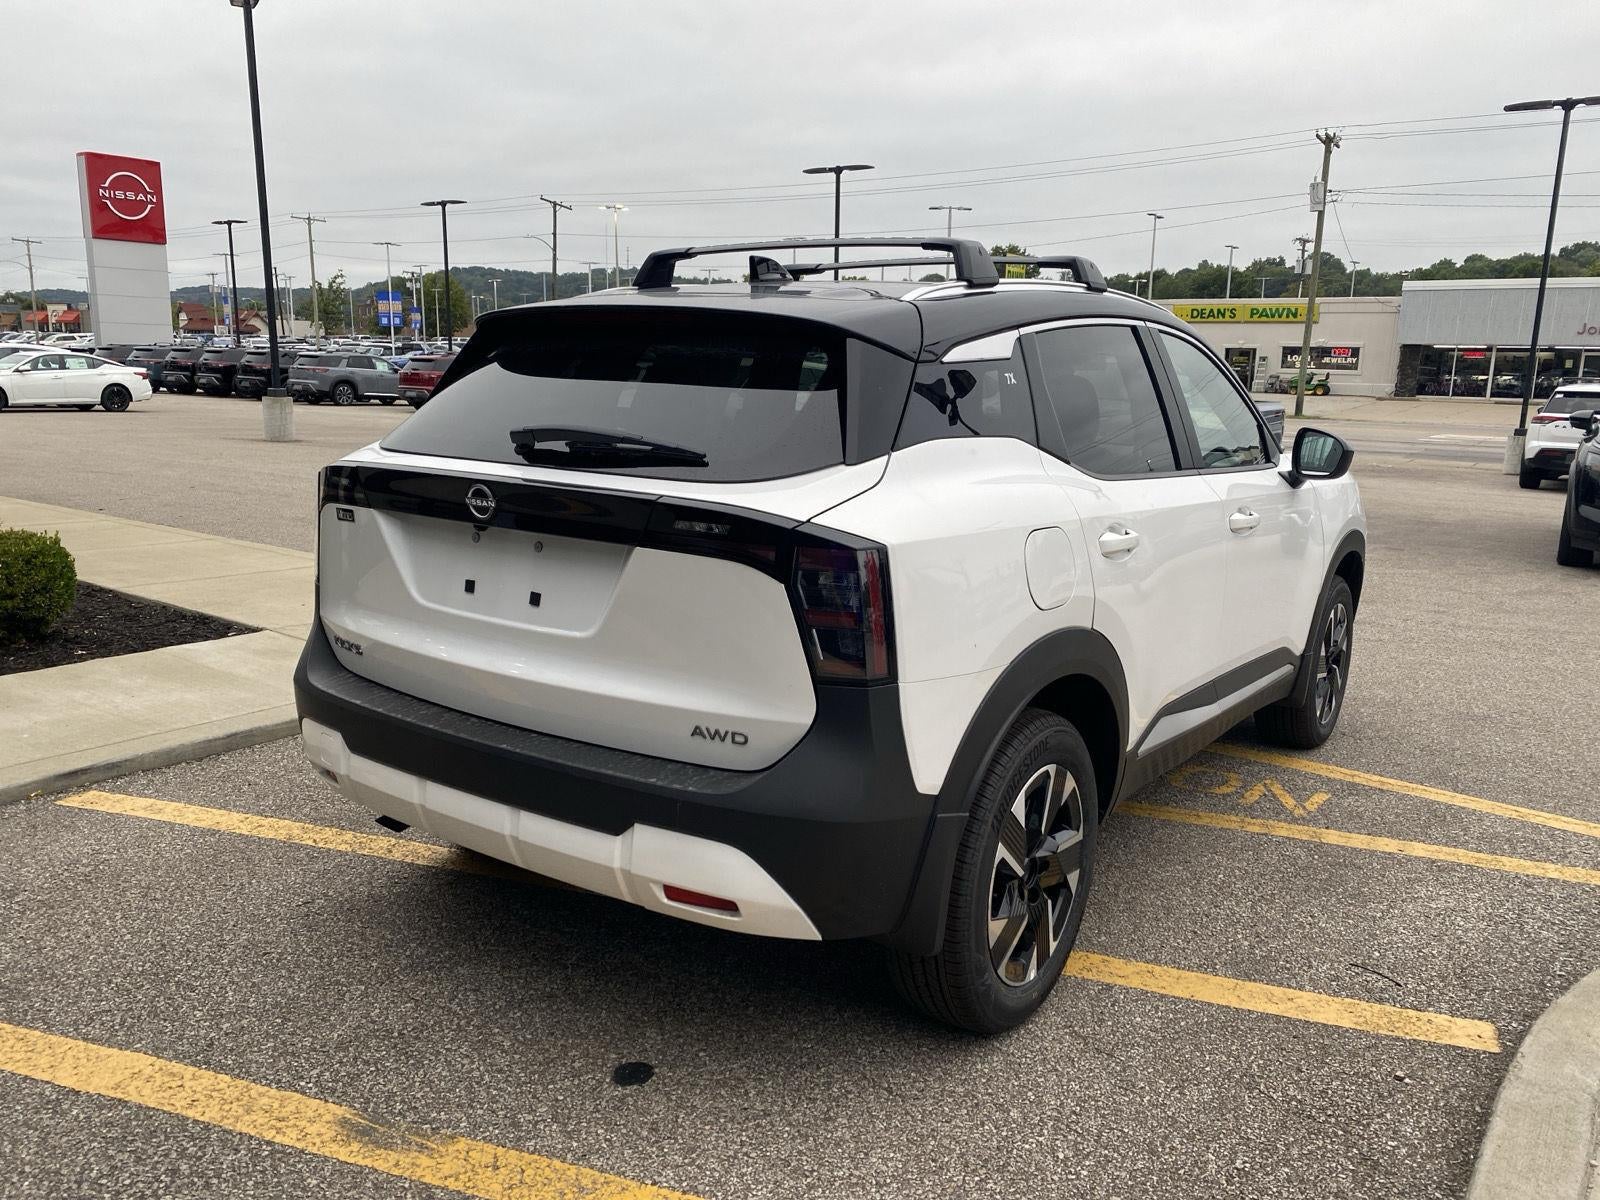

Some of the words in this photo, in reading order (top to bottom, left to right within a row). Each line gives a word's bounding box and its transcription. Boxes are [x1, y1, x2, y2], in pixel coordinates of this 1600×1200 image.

[99, 188, 157, 203] NISSAN
[1190, 307, 1237, 319] DEAN'S
[1249, 307, 1298, 319] PAWN
[1287, 354, 1311, 362] LO
[1321, 356, 1357, 364] JEWELRY
[1294, 361, 1316, 369] SLL
[465, 497, 496, 508] NISSAN
[690, 725, 749, 746] AWD
